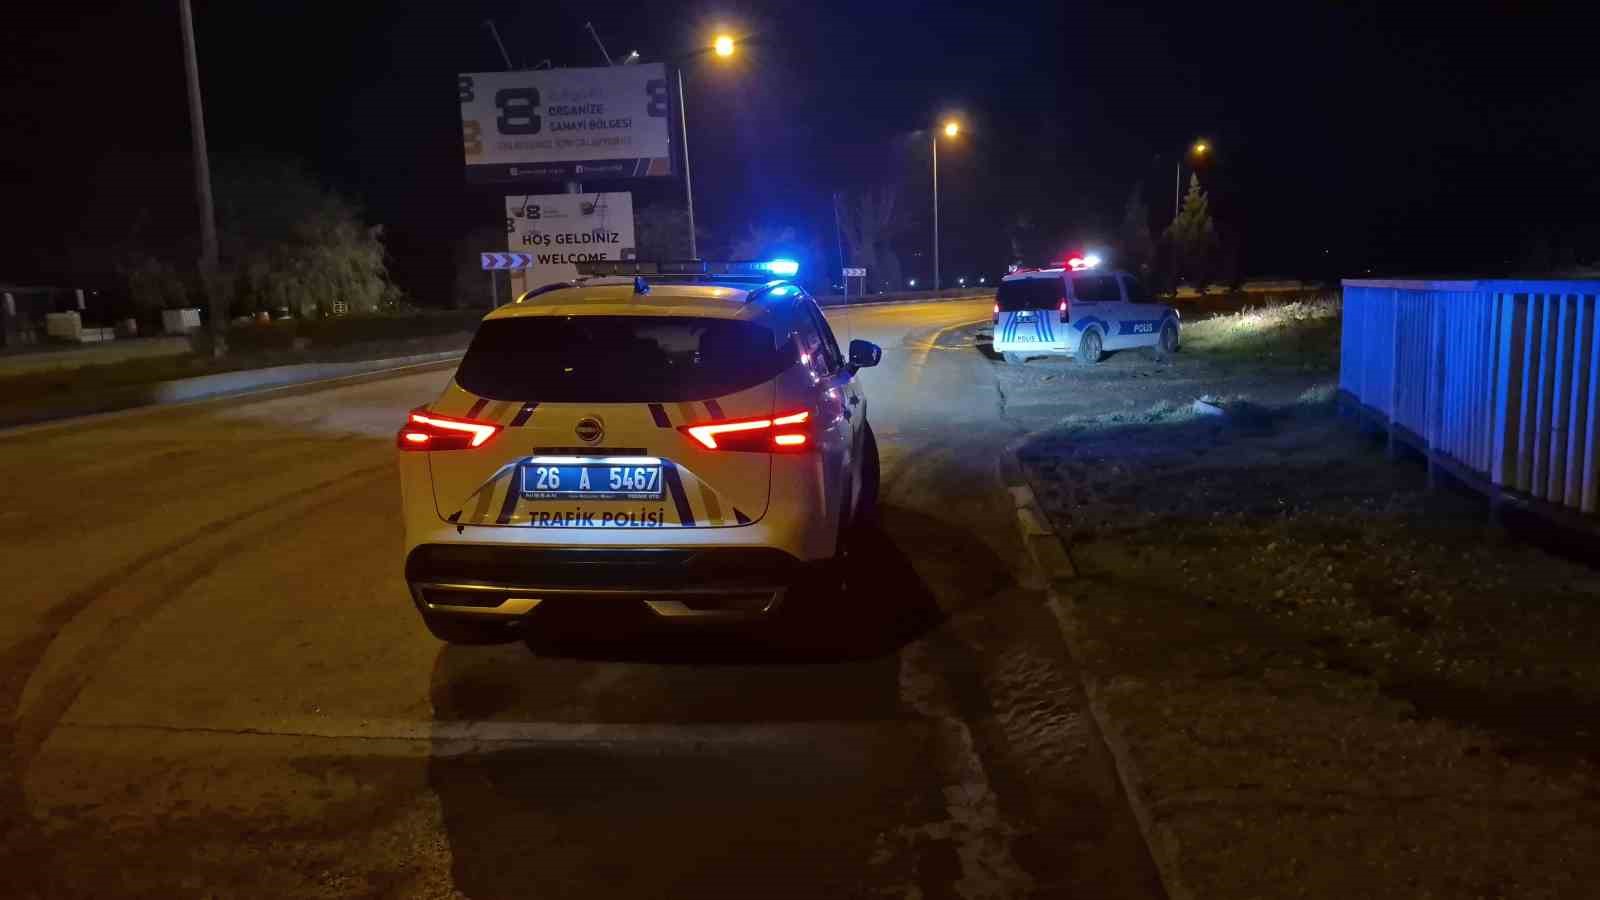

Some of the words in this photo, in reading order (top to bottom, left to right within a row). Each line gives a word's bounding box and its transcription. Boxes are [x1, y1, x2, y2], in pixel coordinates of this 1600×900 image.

[522, 234, 552, 247] HOŞ
[537, 253, 608, 265] WELCOME
[536, 467, 560, 490] 26
[579, 467, 591, 490] A
[609, 467, 658, 490] 5467
[529, 507, 594, 527] TRAFİK
[602, 507, 664, 527] POLİSİ
